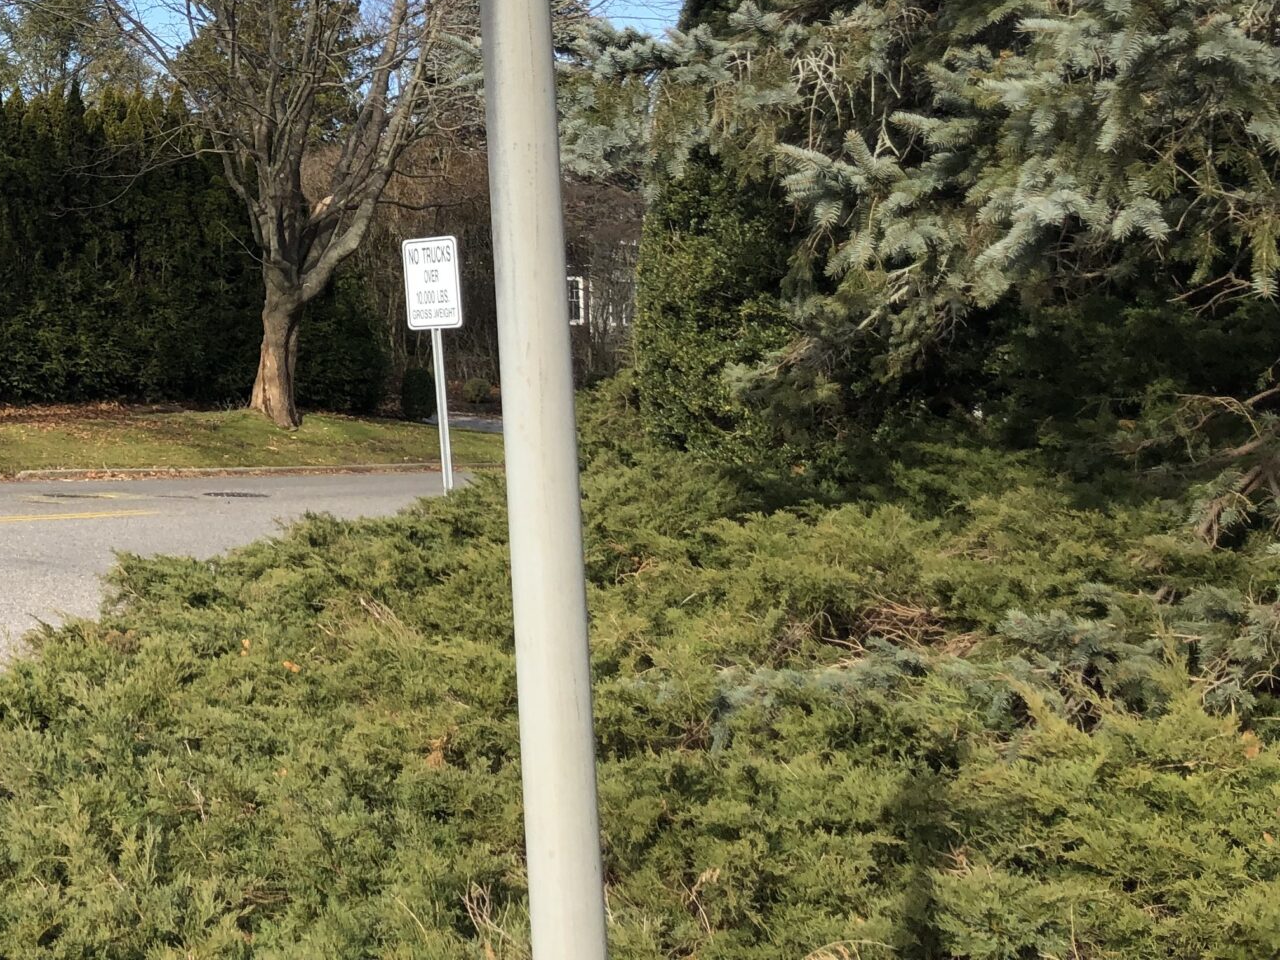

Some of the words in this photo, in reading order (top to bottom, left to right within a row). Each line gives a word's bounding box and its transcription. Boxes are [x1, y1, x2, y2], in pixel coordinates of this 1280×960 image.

[408, 248, 419, 265] NO
[422, 245, 451, 263] TRUCKS
[424, 269, 439, 283] OVER
[413, 309, 432, 320] GROSS
[434, 307, 456, 319] WEIGHT
